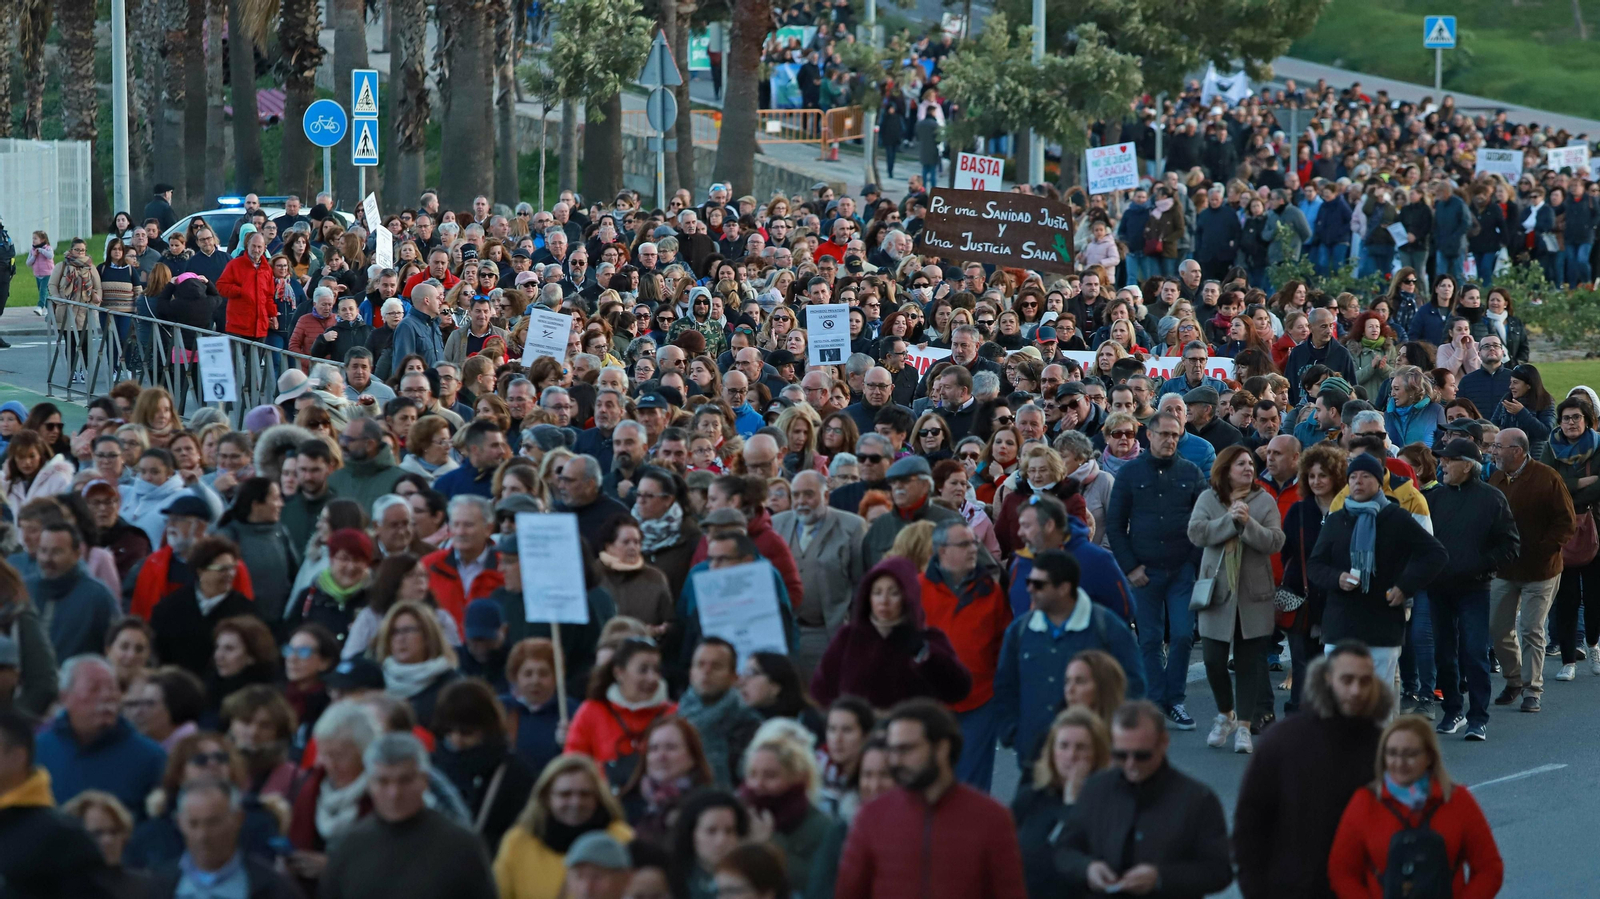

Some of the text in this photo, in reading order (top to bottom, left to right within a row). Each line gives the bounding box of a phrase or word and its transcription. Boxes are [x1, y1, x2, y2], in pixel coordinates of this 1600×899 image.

[960, 155, 1000, 177] BASTA
[1098, 163, 1132, 178] GRACIAS
[971, 177, 985, 190] YA
[930, 196, 951, 214] Por
[955, 207, 978, 217] una
[925, 230, 953, 248] Una
[1021, 241, 1057, 262] SANA
[904, 354, 937, 375] SIN
